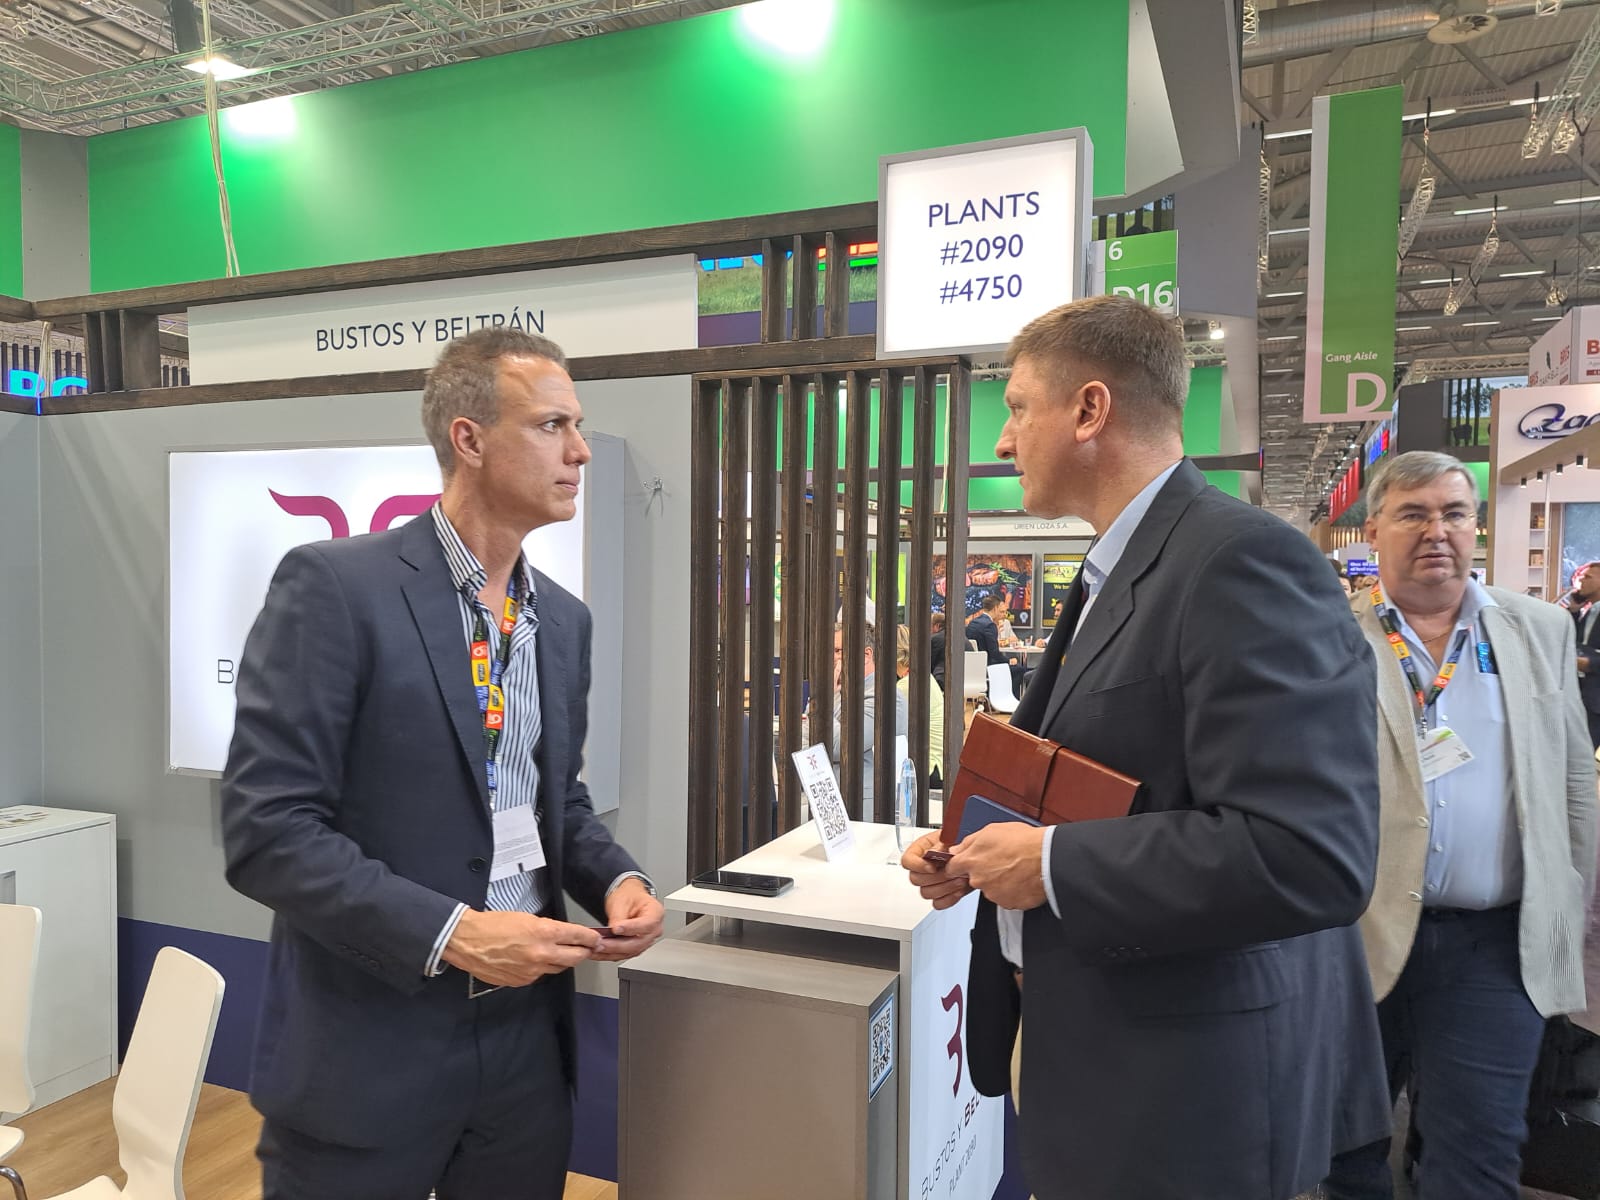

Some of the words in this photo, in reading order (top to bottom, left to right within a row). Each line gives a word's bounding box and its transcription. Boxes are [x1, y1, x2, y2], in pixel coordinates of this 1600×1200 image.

[928, 191, 1040, 228] PLANTS
[940, 234, 1023, 265] #2090
[1108, 240, 1123, 261] 6
[939, 273, 1022, 304] #4750
[316, 321, 404, 352] BUSTOS
[412, 320, 426, 343] Y
[1325, 353, 1352, 364] Gang
[1353, 351, 1378, 361] Aisle
[1346, 372, 1387, 414] D
[921, 1130, 956, 1200] BUSTOS
[957, 1117, 963, 1140] Y
[964, 1089, 982, 1128] BEL
